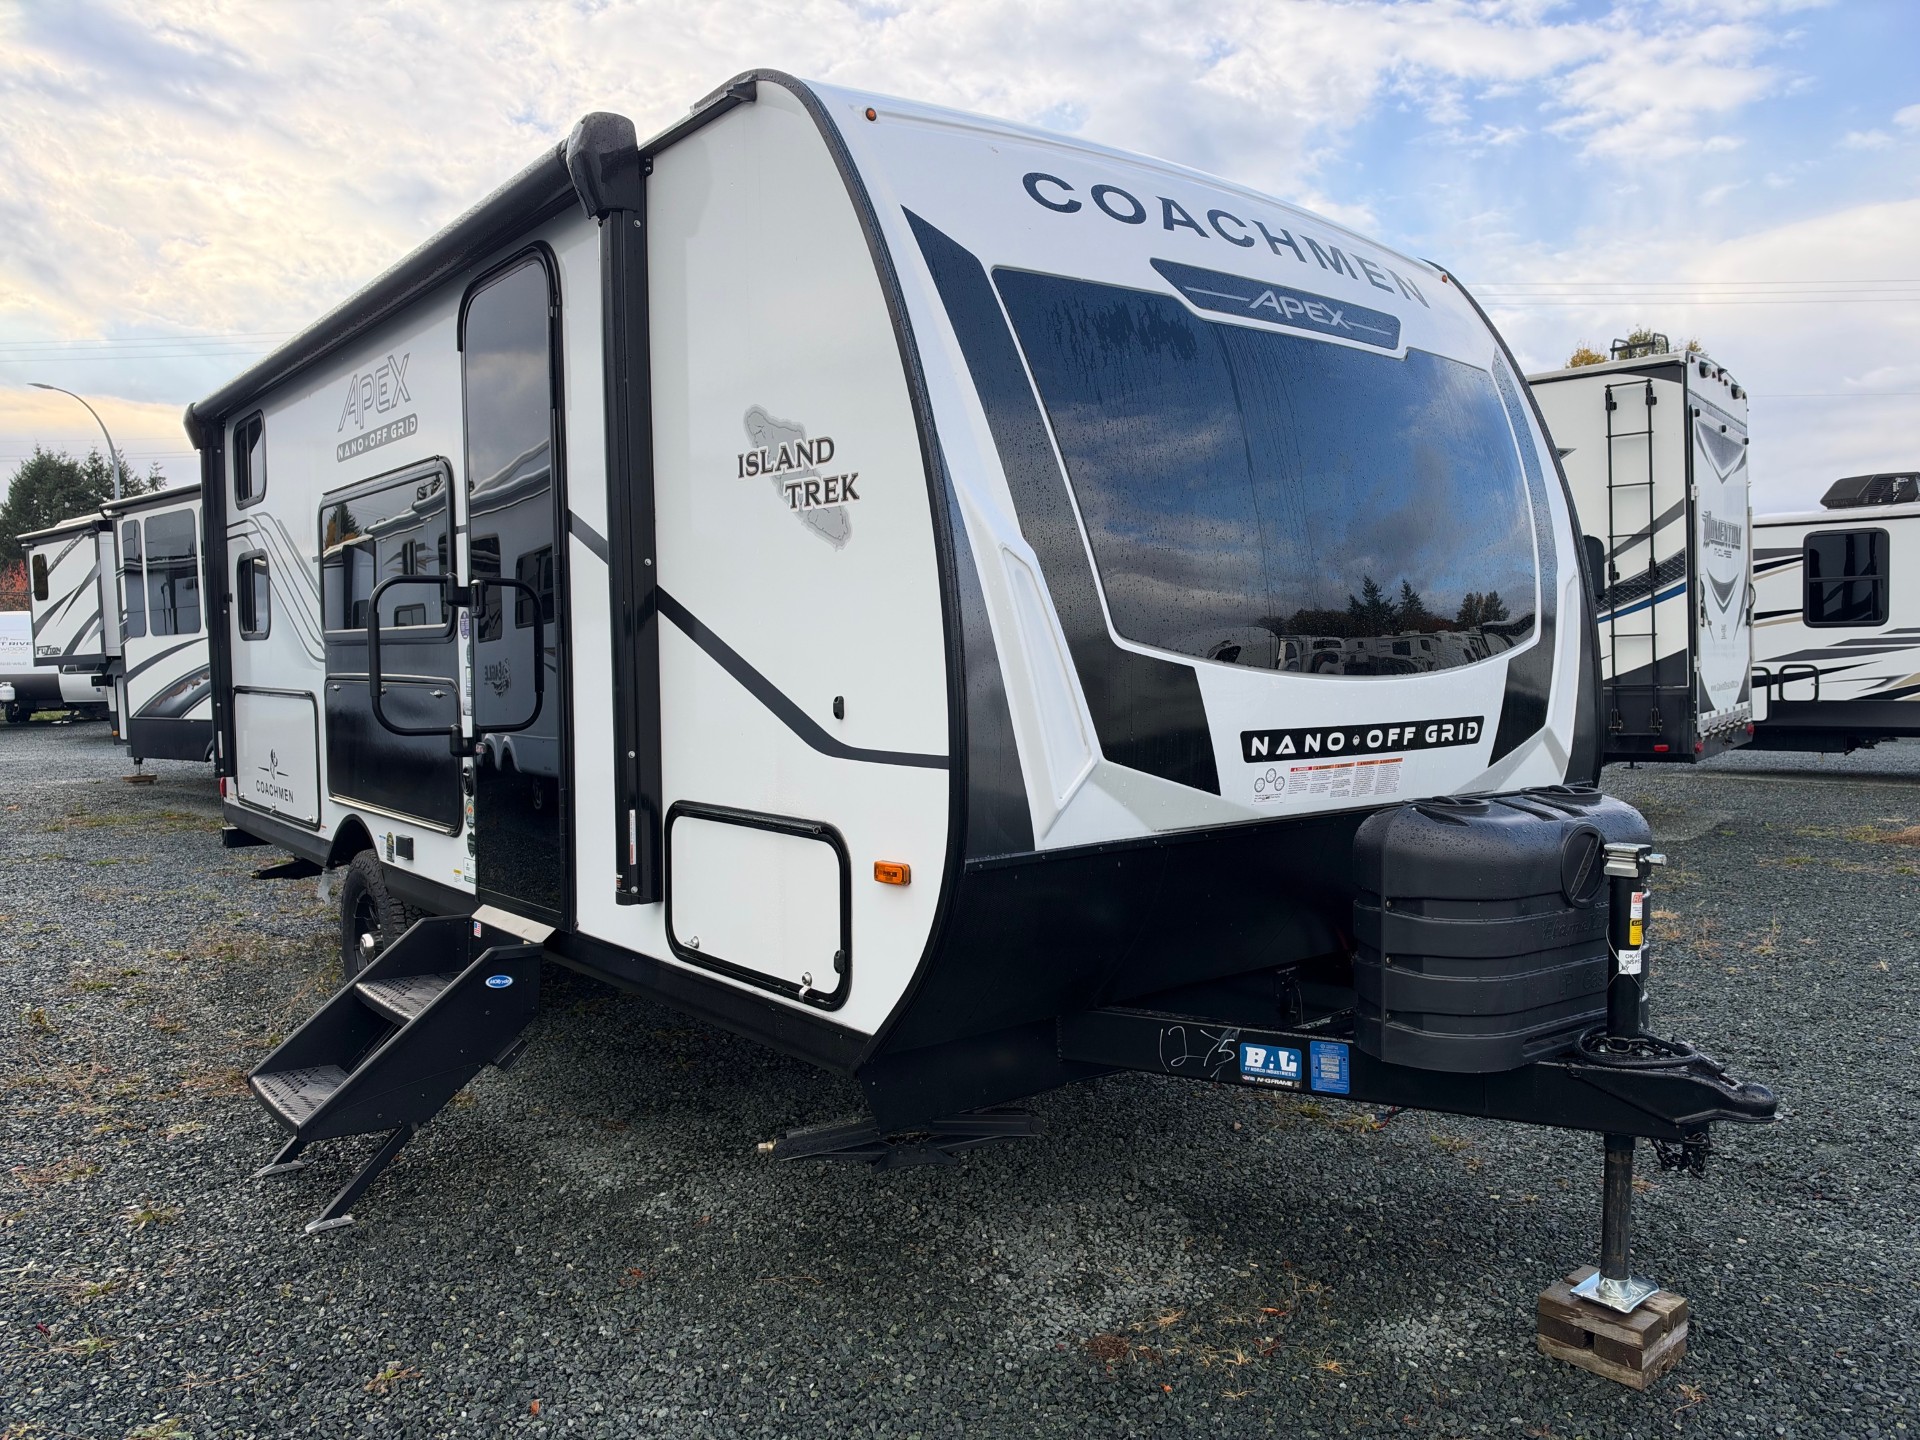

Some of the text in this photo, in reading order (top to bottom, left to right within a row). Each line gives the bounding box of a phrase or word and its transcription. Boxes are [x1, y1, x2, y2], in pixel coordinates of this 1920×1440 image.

[1022, 172, 1431, 309] COACHMEN
[1249, 289, 1352, 330] APEX
[338, 352, 411, 432] APEX
[390, 416, 417, 439] GRID
[737, 436, 835, 478] ISLAND
[785, 472, 860, 509] TREK
[1424, 721, 1479, 744] GRID
[255, 779, 294, 804] COACHMEN
[1245, 1046, 1298, 1073] BAL
